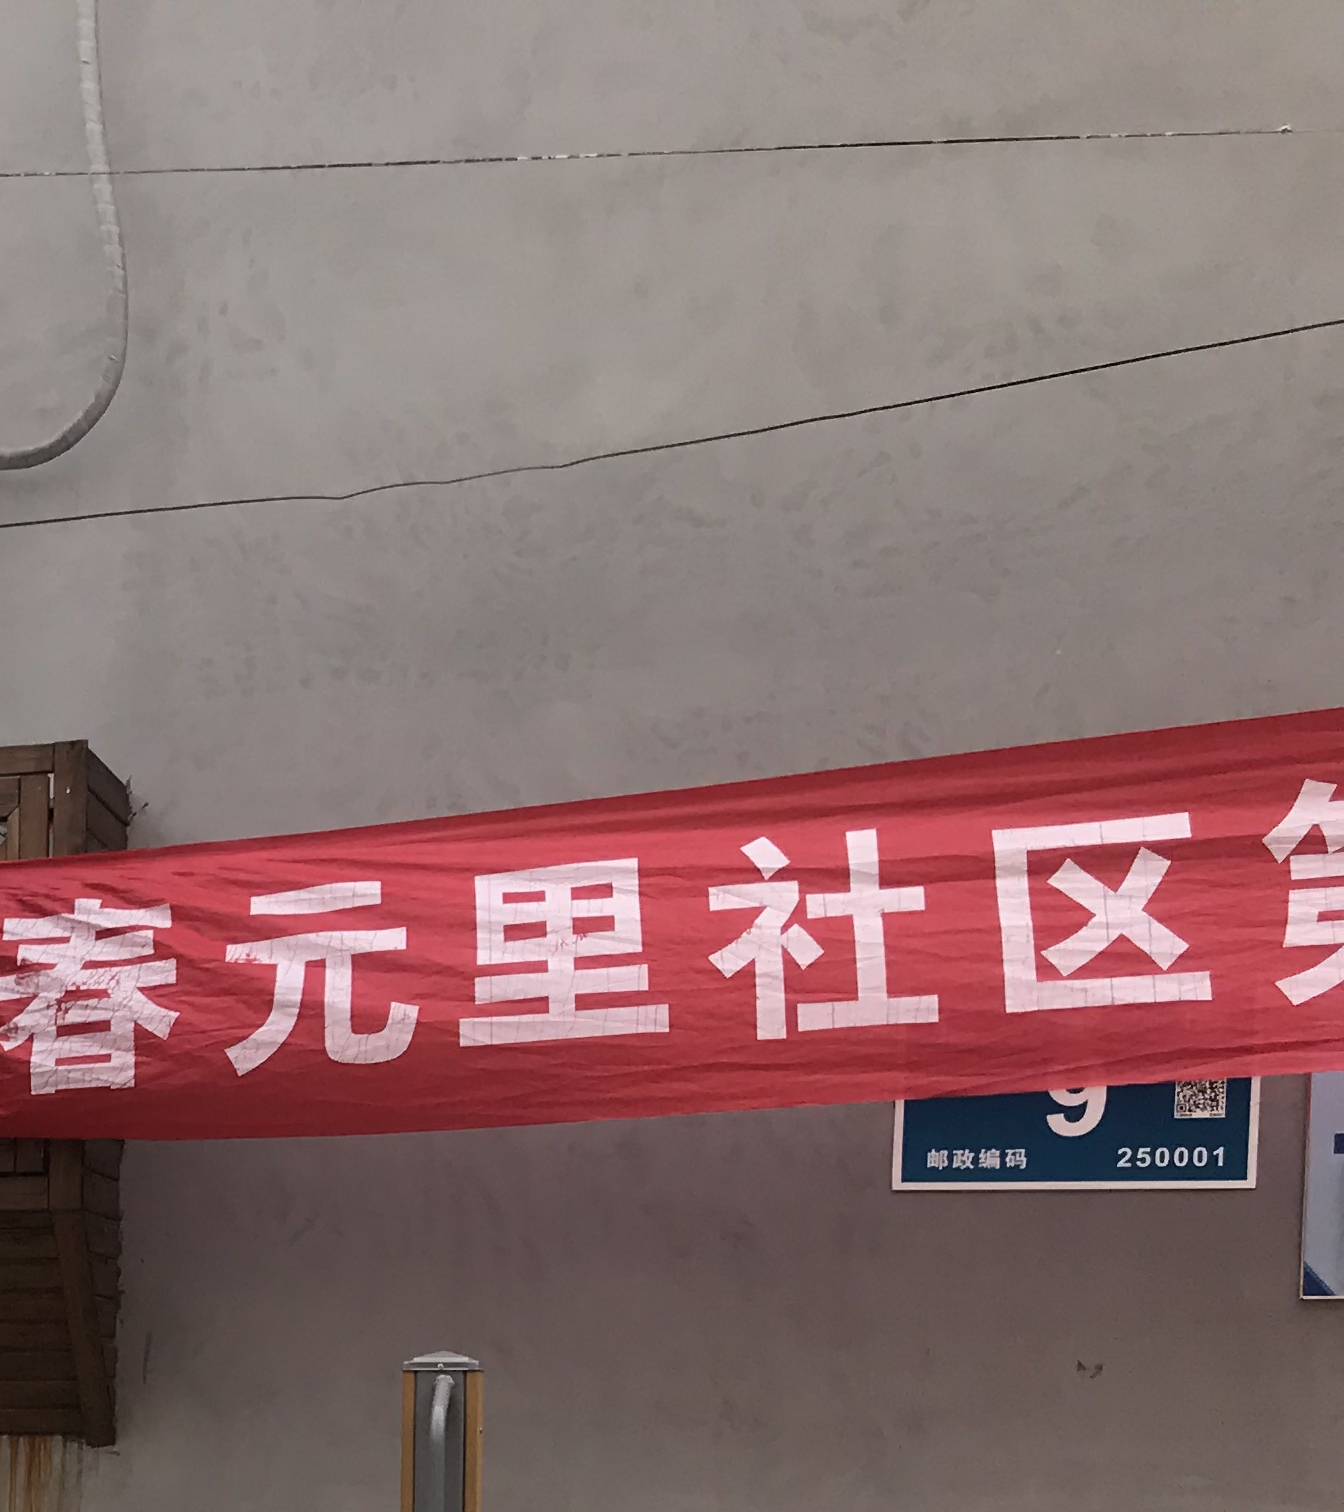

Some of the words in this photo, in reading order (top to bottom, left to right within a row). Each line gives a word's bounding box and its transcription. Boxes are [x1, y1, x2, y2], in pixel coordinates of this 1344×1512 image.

[927, 1148, 1028, 1170] 邮政编码
[1117, 1146, 1225, 1169] 250001
